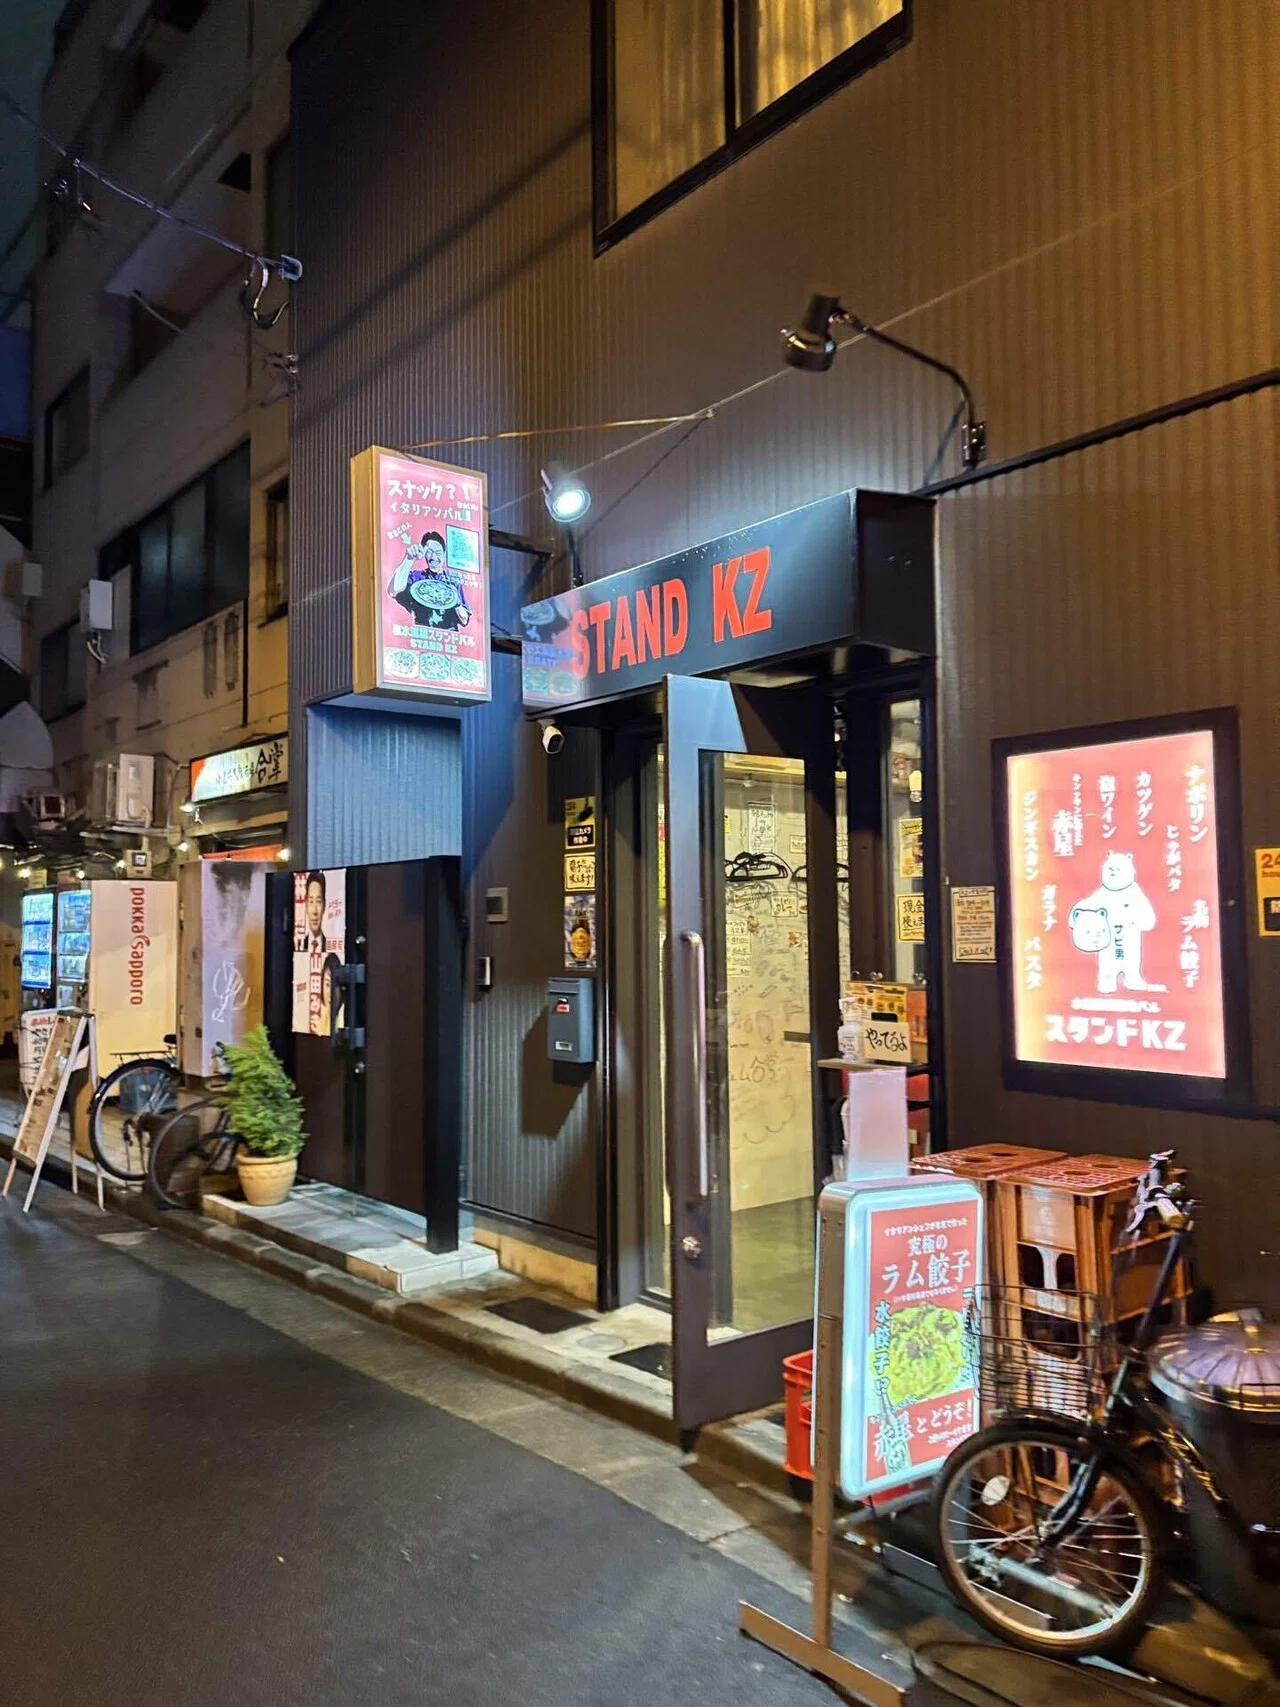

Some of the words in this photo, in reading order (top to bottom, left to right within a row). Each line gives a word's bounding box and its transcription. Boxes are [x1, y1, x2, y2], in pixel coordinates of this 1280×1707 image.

[570, 578, 688, 680] STAND
[713, 546, 772, 644] KZ
[1136, 771, 1153, 836] カツゲン
[128, 887, 146, 934] pokka
[1045, 1014, 1188, 1051] スタンドKZ
[881, 1249, 971, 1294] ラム餃子
